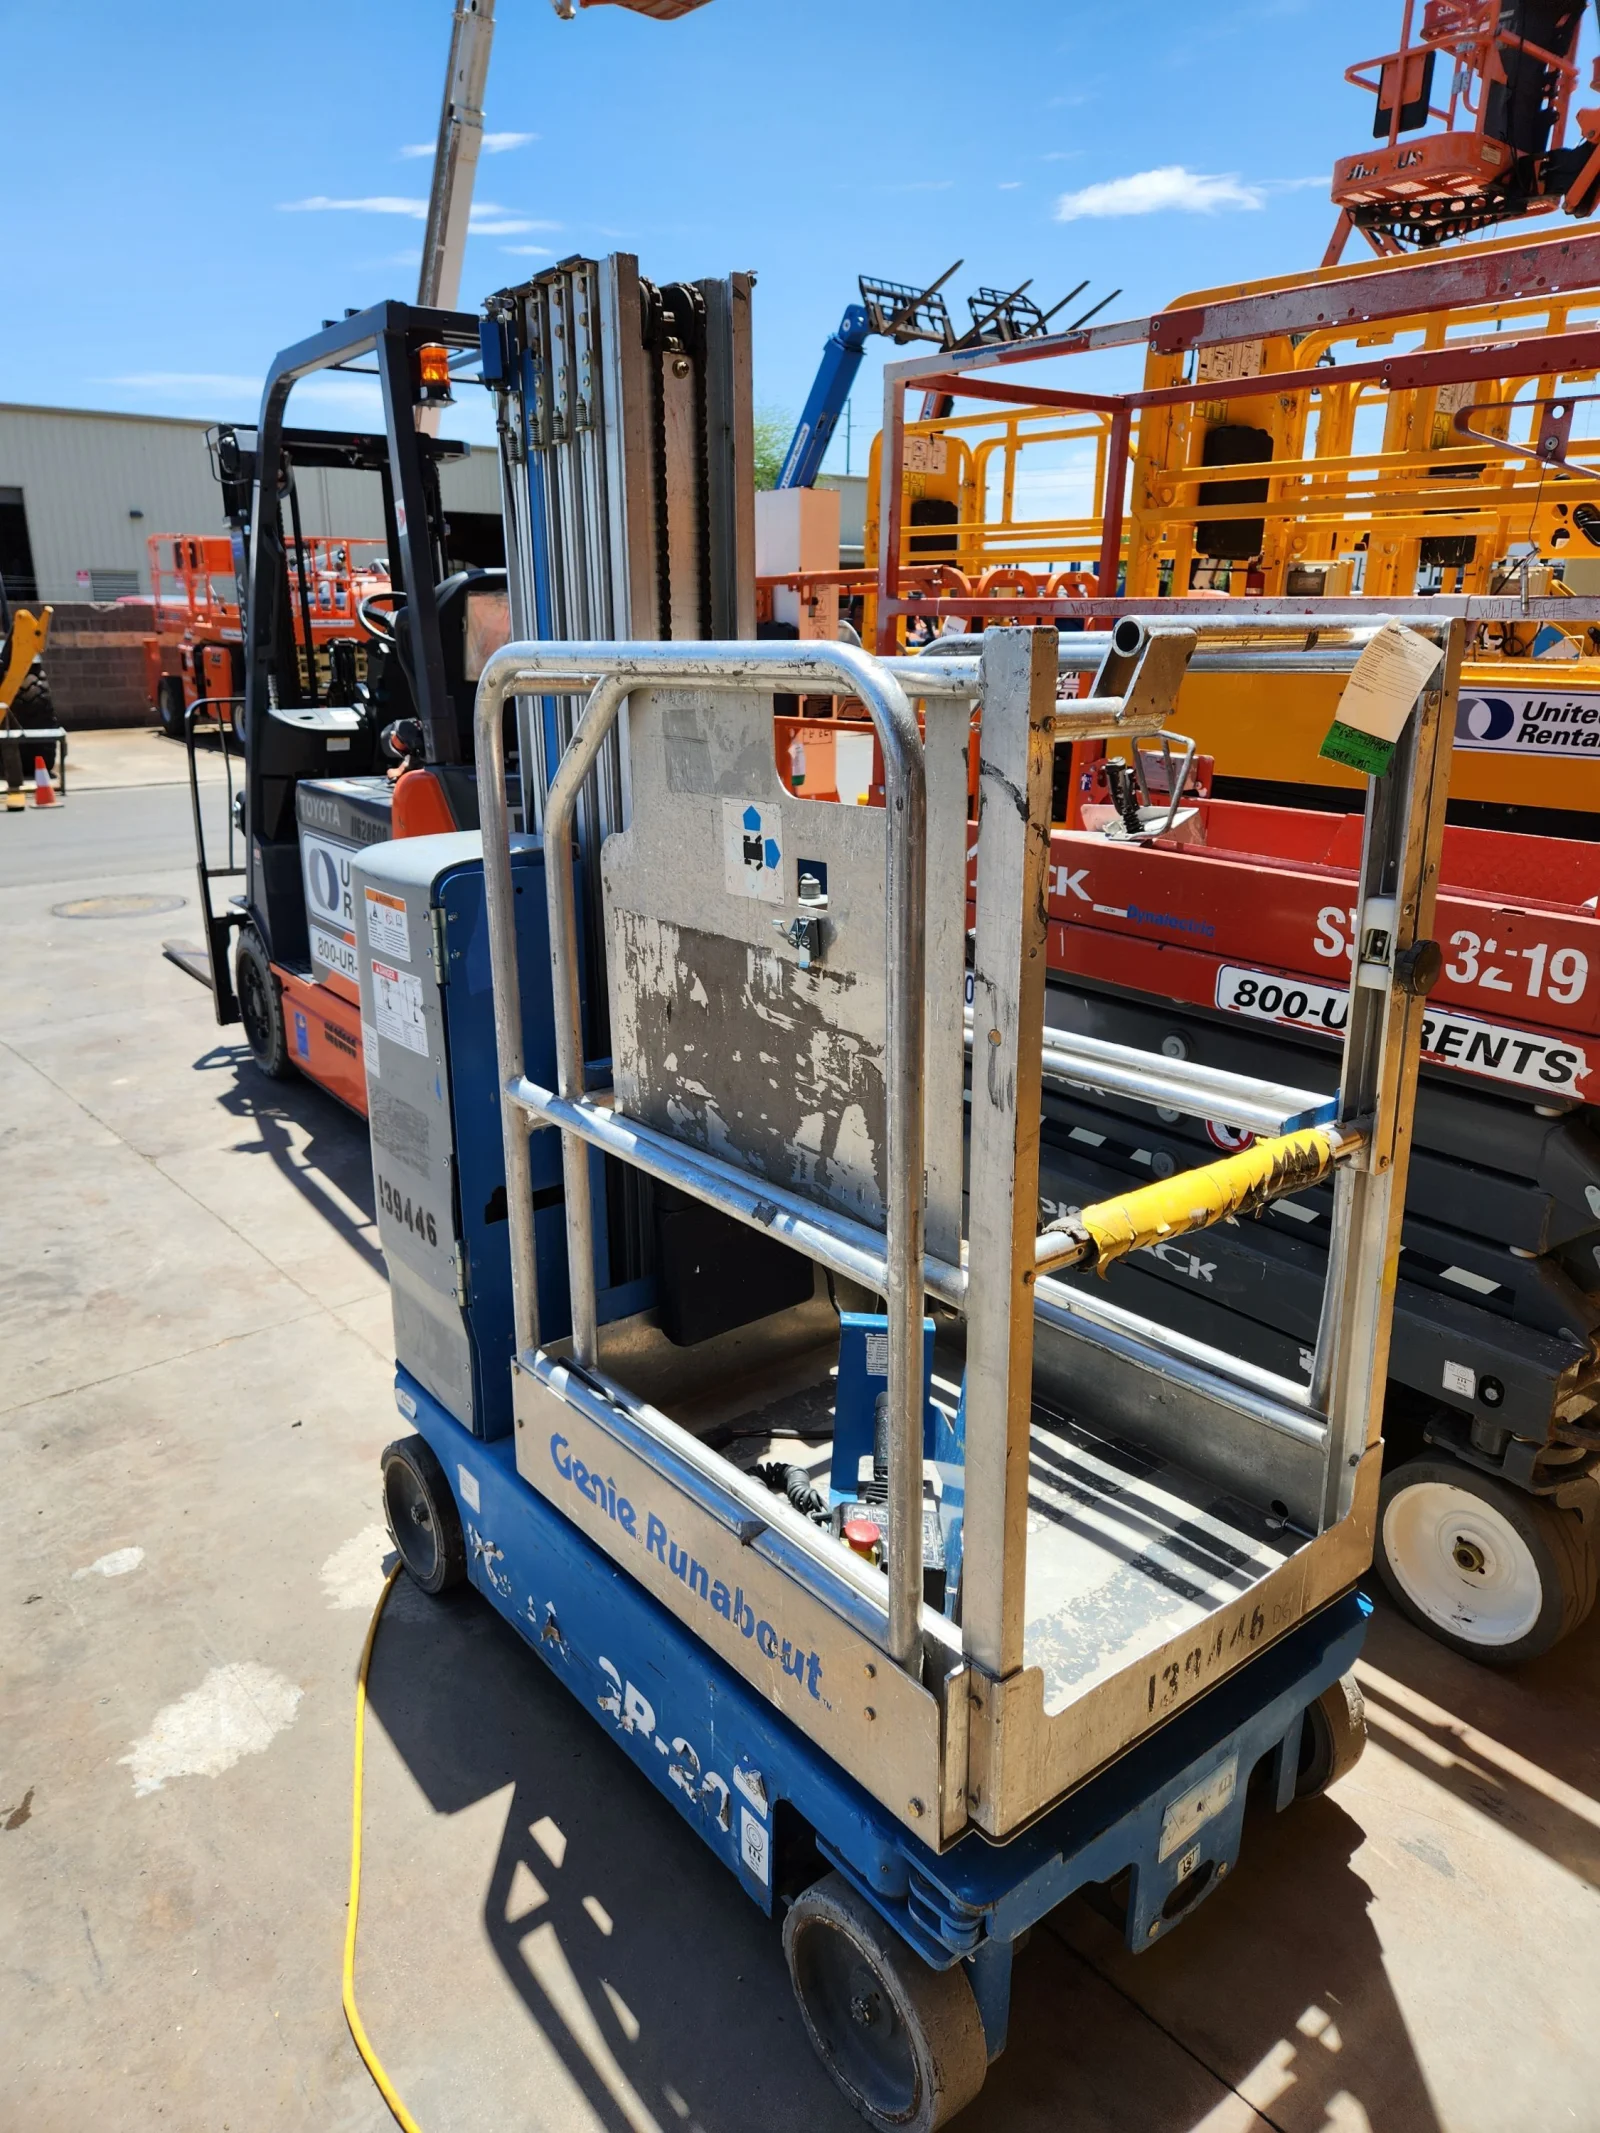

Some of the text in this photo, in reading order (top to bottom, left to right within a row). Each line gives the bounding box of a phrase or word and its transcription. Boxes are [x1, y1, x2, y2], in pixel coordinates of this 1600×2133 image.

[1522, 701, 1600, 724] Unite
[1516, 723, 1600, 748] Renta
[300, 794, 341, 828] TOYOTA
[549, 1431, 637, 1541] Genie
[646, 1510, 824, 1700] Runabout
